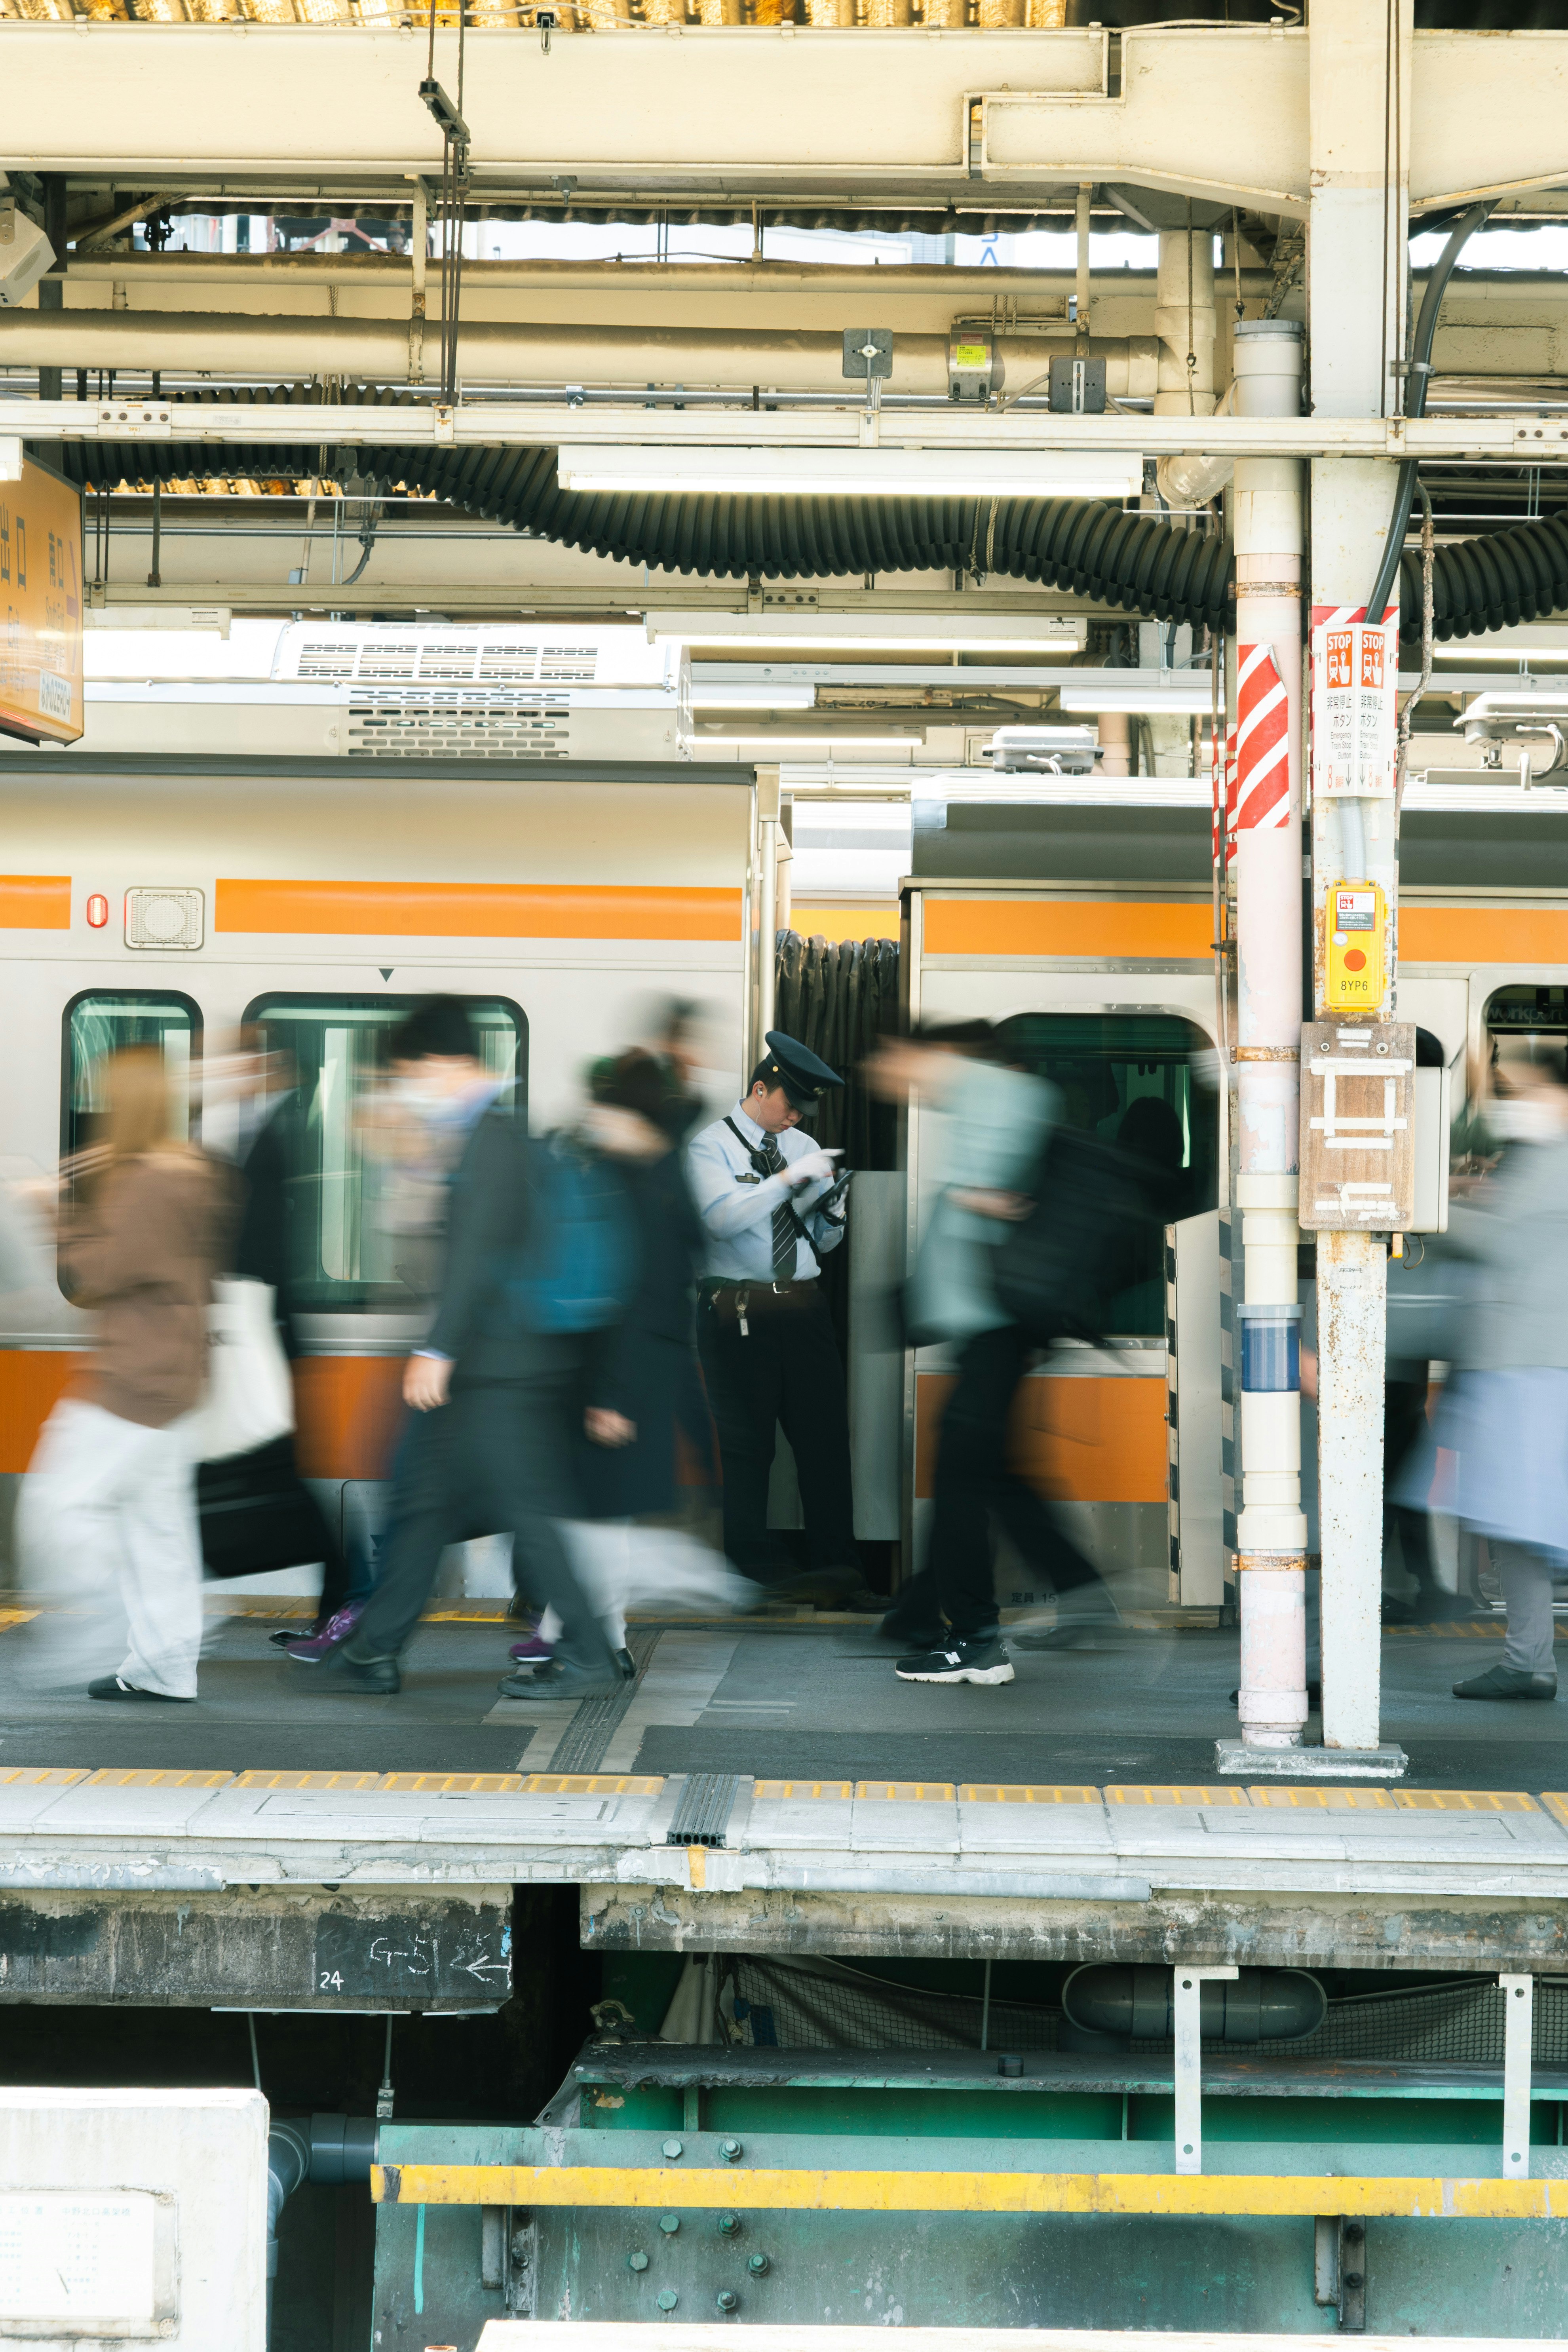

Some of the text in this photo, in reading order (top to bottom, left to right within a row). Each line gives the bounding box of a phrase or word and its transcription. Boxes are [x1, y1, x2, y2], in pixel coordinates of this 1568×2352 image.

[1327, 634, 1352, 650] STOP
[1363, 633, 1384, 650] STOP
[1327, 694, 1352, 710] 非常停止
[1361, 694, 1384, 710] 非常停止
[1333, 713, 1352, 728] ボタン
[1360, 713, 1378, 727] ボタン
[1331, 731, 1351, 740] Emergency
[1360, 730, 1379, 740] Emergency
[1342, 742, 1351, 750] Stop
[1370, 742, 1378, 751] Stop
[1360, 751, 1372, 759] Button
[1341, 981, 1368, 991] 8YP6
[1011, 1592, 1034, 1603] 定員
[945, 1651, 961, 1665] N
[320, 1970, 344, 1991] 24
